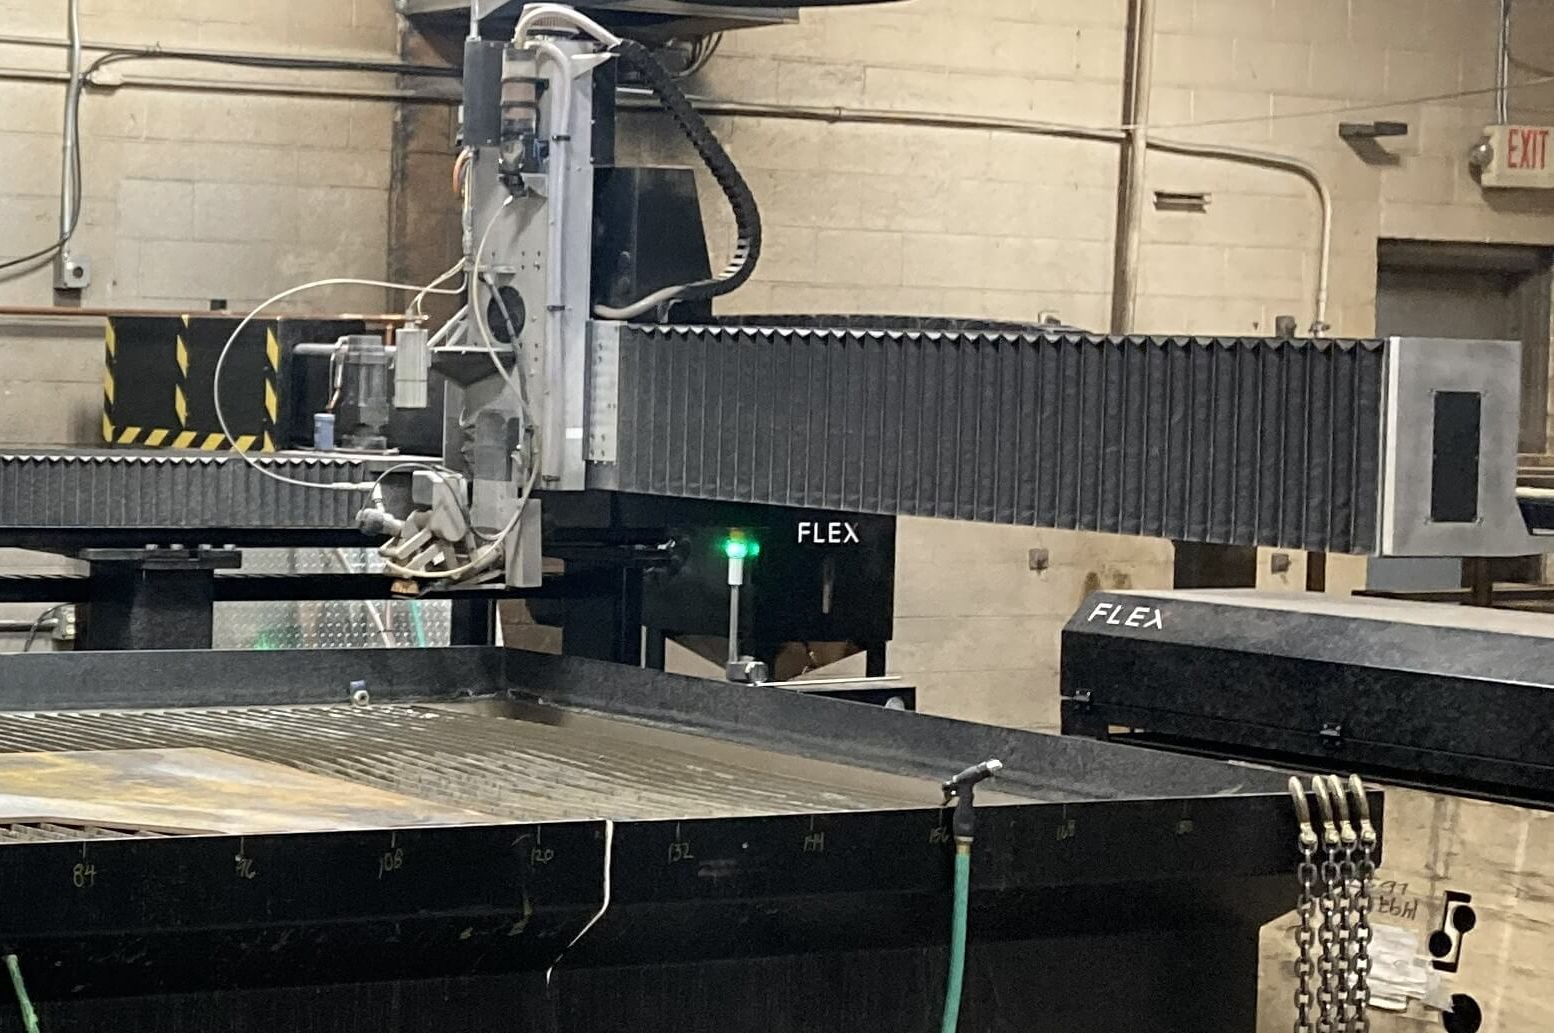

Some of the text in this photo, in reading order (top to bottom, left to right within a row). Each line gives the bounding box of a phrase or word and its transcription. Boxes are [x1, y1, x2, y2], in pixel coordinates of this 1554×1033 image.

[1507, 128, 1549, 170] EXIT
[797, 521, 860, 544] FLEX
[1087, 602, 1164, 630] FLEX
[73, 862, 96, 887] 84
[378, 847, 404, 880] 108
[531, 847, 555, 865] 120
[668, 842, 695, 865] 132
